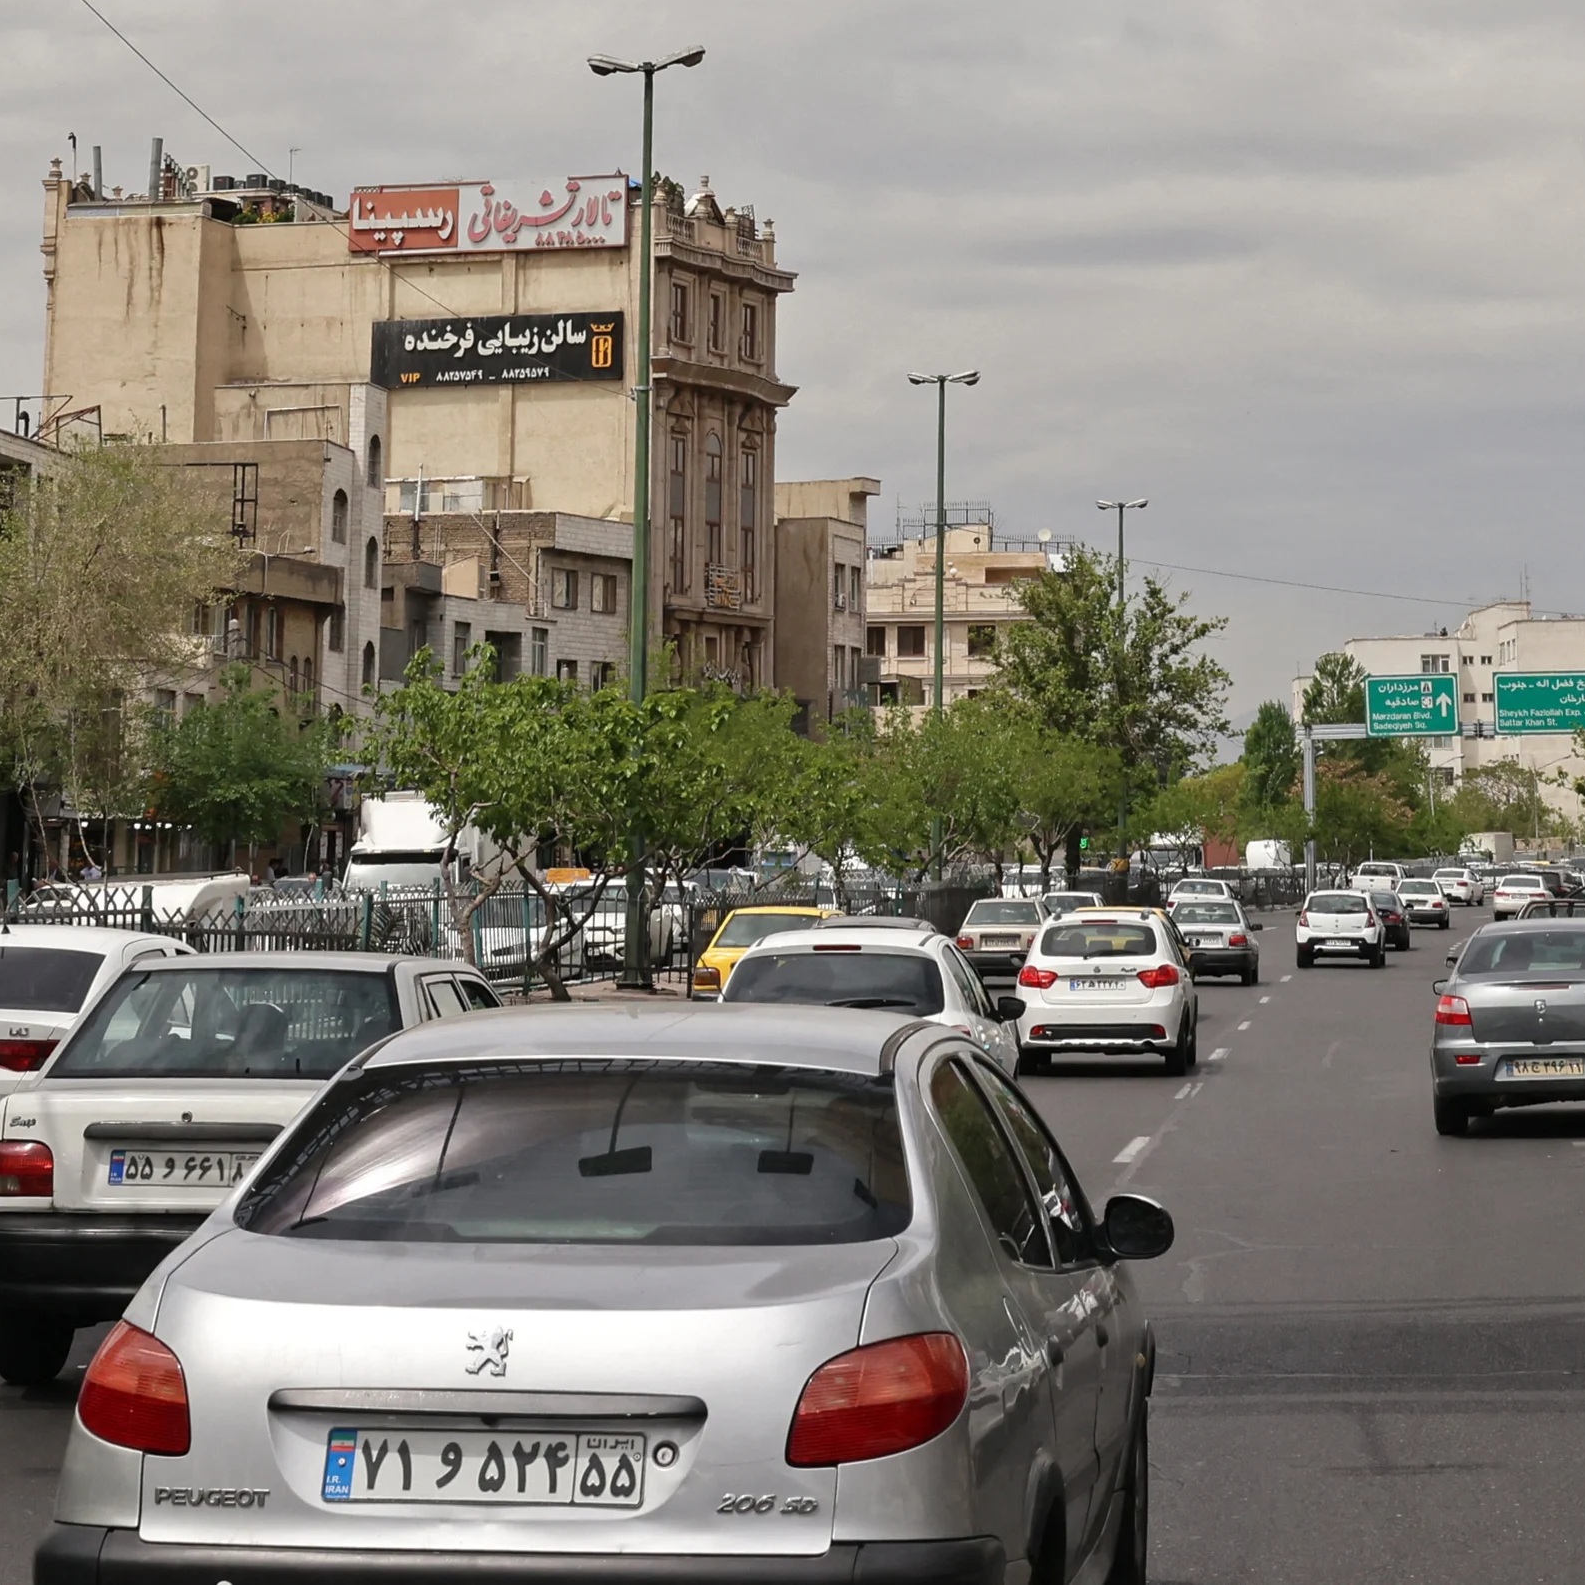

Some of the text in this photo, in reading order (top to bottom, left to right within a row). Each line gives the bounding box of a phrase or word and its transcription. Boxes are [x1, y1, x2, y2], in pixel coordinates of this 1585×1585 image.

[353, 181, 623, 247] تالار تشریفاتی رسپینا
[404, 319, 587, 358] سالن زیبایی فرخنده
[400, 372, 421, 384] VIP
[1378, 683, 1419, 694] مرزداران
[1499, 680, 1527, 692] جنوب
[1536, 679, 1550, 688] اله
[1551, 679, 1574, 691] فضل
[1385, 697, 1420, 709] صادقیه
[1372, 712, 1433, 721] Marzdaran Blvd.
[1499, 708, 1529, 718] Sheykh
[1565, 708, 1582, 718] Exp.
[1373, 721, 1427, 731] Sadeqiyeh Sq.
[1499, 718, 1558, 727] Sattar Khan St.
[125, 1155, 153, 1179] ۵۵
[163, 1157, 176, 1179] و
[183, 1156, 224, 1181] ۶۶۱
[587, 1437, 635, 1450] ایران
[362, 1438, 637, 1498] ۷۱ و ۵۲۴ ۵۵
[326, 1475, 341, 1484] I.R.
[325, 1485, 349, 1494] IRAN
[154, 1486, 818, 1515] PEUGEOT 206 SD
